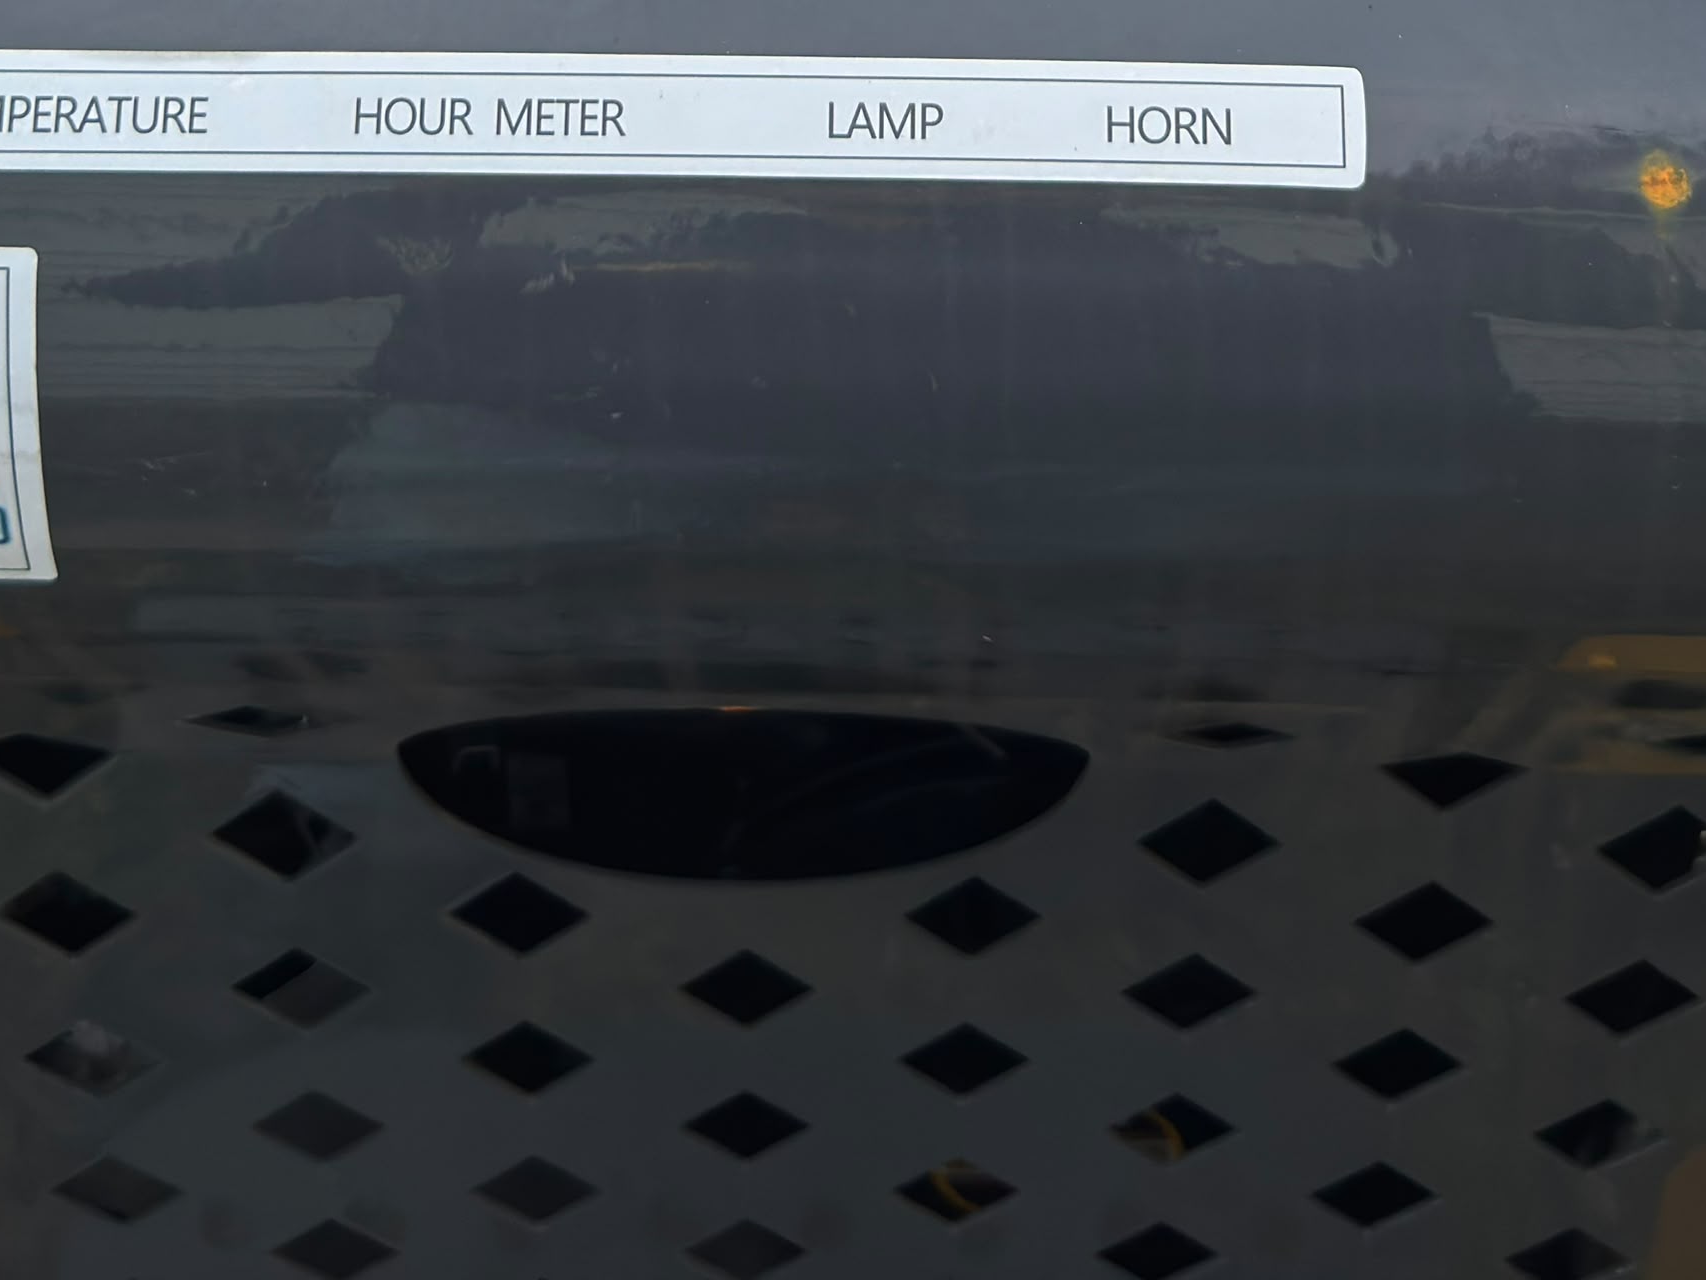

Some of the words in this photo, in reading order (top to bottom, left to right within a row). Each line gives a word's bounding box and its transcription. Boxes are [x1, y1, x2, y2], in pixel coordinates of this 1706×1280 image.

[354, 97, 474, 136] HOUR
[495, 98, 626, 137] METER
[828, 101, 944, 140] LAMP
[1106, 105, 1232, 146] HORN
